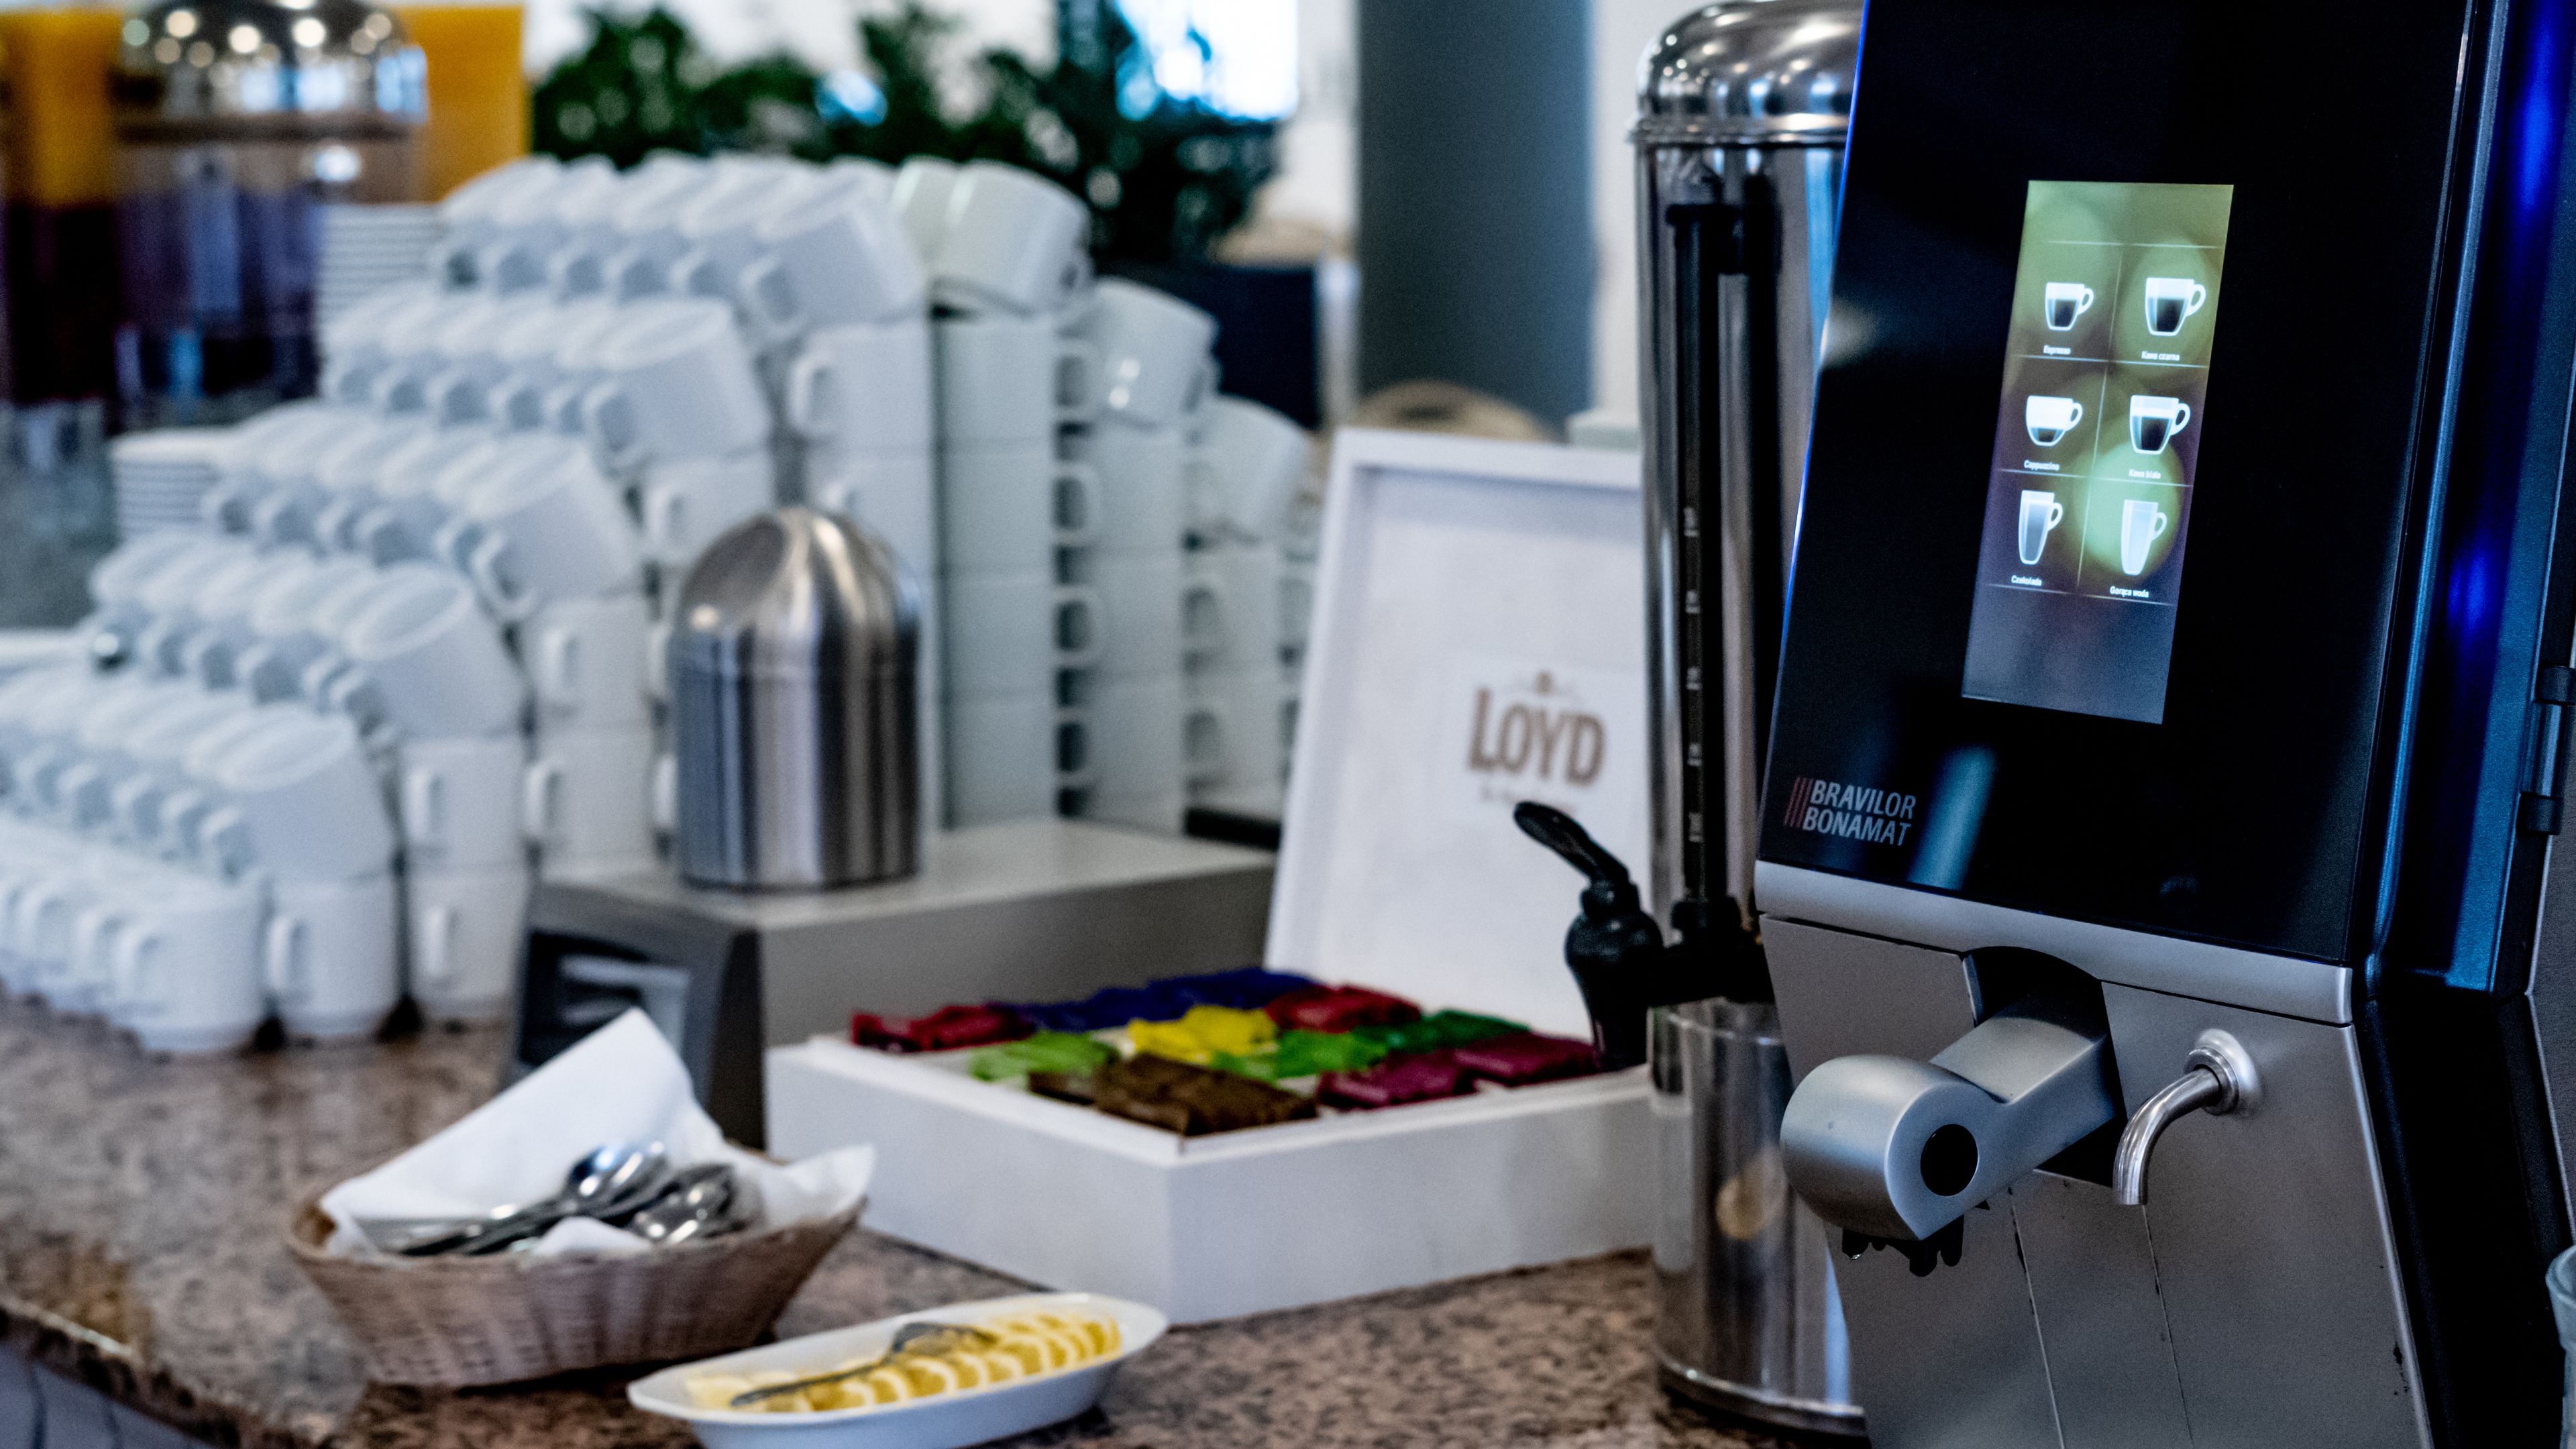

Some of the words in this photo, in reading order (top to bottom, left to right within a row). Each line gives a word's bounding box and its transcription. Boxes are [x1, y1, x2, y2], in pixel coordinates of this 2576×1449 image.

[2043, 345, 2070, 355] Espresso
[2141, 351, 2157, 360] Kawa
[2159, 353, 2180, 361] czarna
[2025, 460, 2059, 471] Cappuccino
[2129, 469, 2145, 478] Kawa
[2011, 575, 2042, 586] Czekolada
[2110, 586, 2132, 597] Gorąca
[2133, 589, 2149, 598] woda
[1468, 687, 1607, 786] LOYD
[1810, 780, 1917, 820] BRAVILOR
[1802, 806, 1912, 847] BONAMAT
